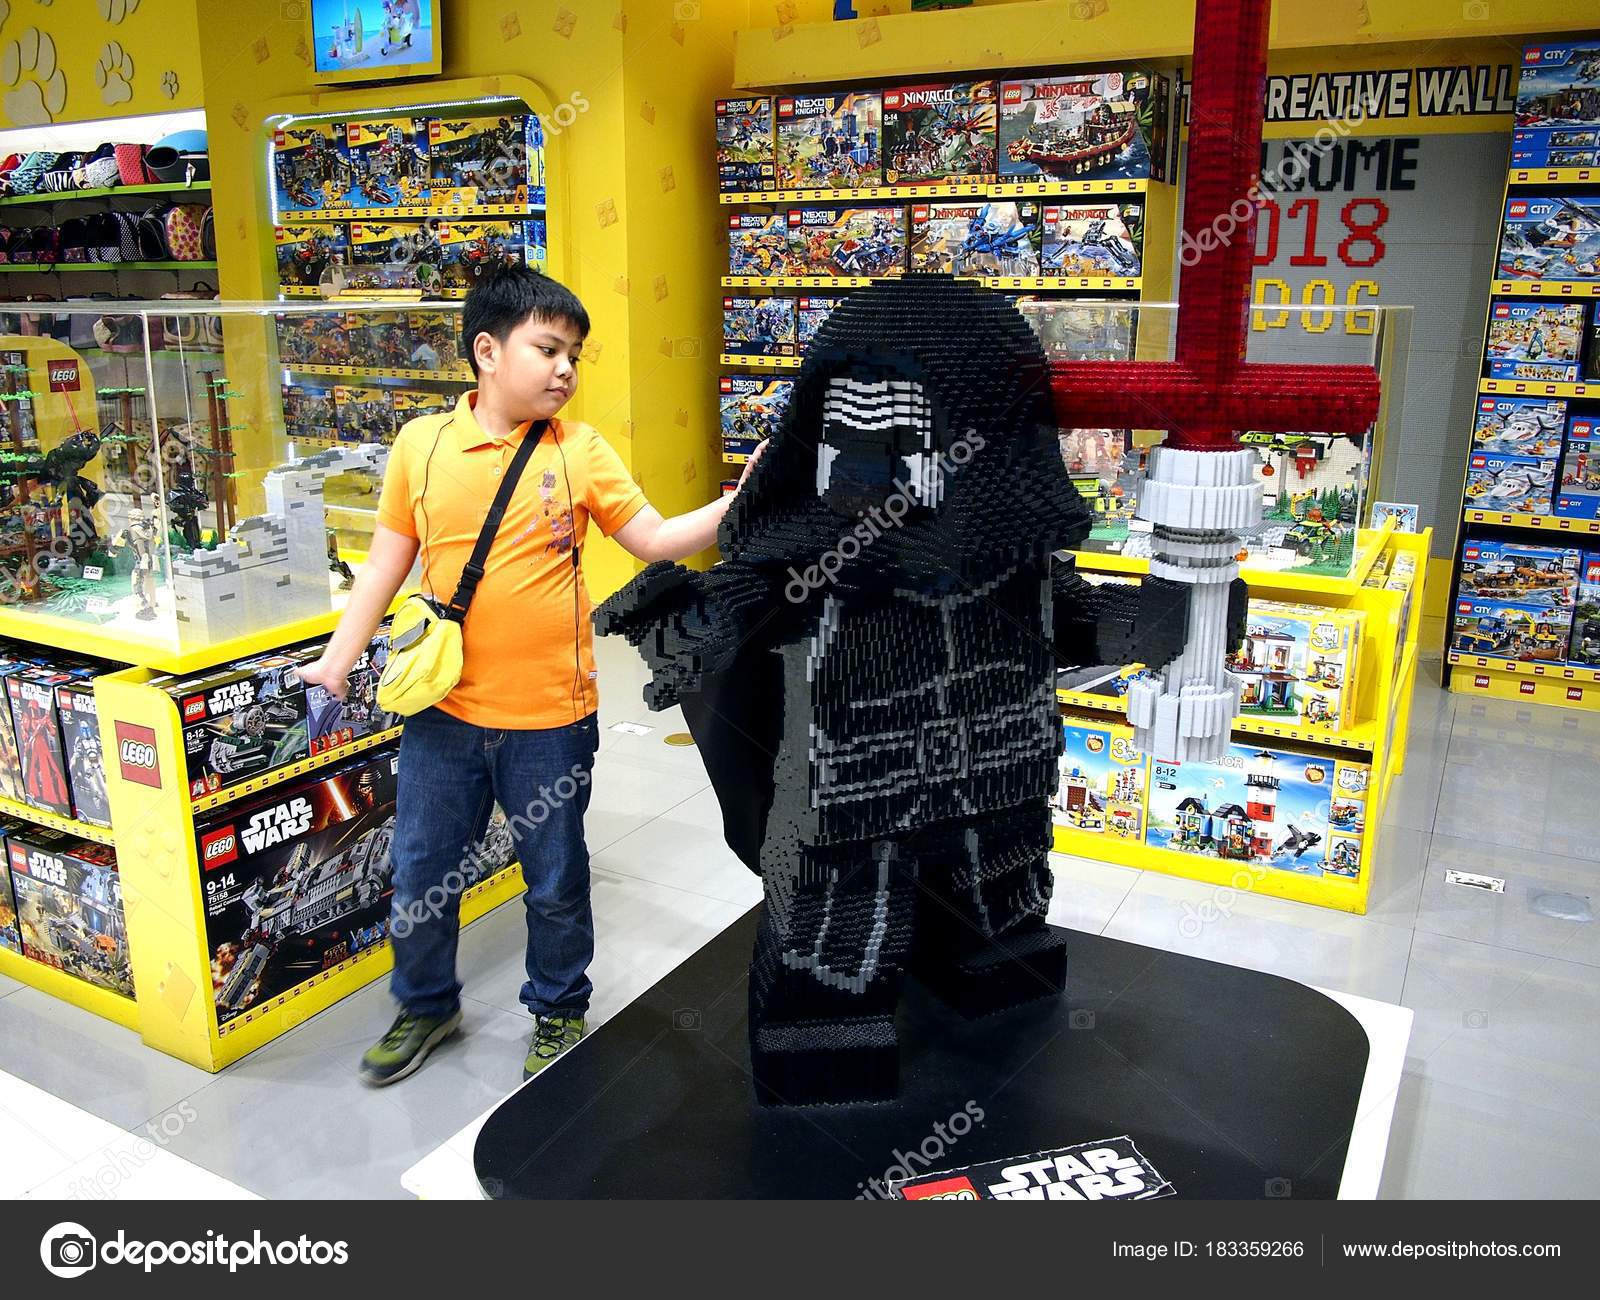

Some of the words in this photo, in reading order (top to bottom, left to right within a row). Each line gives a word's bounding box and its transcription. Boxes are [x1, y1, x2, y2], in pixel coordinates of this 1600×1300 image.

[1544, 50, 1566, 60] CITY
[1004, 89, 1021, 100] LEGO
[1035, 82, 1091, 98] NINJAGO
[1267, 73, 1409, 120] REATIVE
[1420, 68, 1515, 115] WALL
[795, 98, 825, 108] NEXO
[884, 96, 899, 105] LEGO
[902, 89, 955, 106] NINJAGO
[779, 103, 793, 113] LEGO
[795, 106, 825, 115] KNIGHTS
[884, 113, 898, 121] 8-14
[802, 210, 828, 219] NEXO
[936, 207, 977, 219] NINJAGO
[1066, 208, 1108, 220] NINJAGO
[1530, 205, 1554, 214] CITY
[1252, 199, 1390, 267] 018
[1252, 279, 1380, 335] DOG
[1511, 307, 1530, 316] CITY
[51, 368, 77, 383] LEGO
[1497, 402, 1515, 410] CITY
[1573, 425, 1590, 433] LEGO
[1569, 442, 1586, 450] 5-12
[1465, 550, 1479, 558] LEGO
[1481, 551, 1500, 560] CITY
[1587, 566, 1600, 576] LEG
[1458, 604, 1472, 612] LEGO
[1474, 606, 1492, 614] CITY
[213, 680, 256, 703] STAR
[310, 689, 326, 700] 7-12
[208, 690, 256, 716] WARS
[184, 702, 206, 717] LEGO
[186, 728, 205, 741] 8-12
[120, 738, 157, 770] LEGO
[1155, 766, 1177, 777] 8-12
[241, 797, 313, 838] STAR
[241, 816, 314, 855] WARS
[205, 836, 236, 861] LEGO
[29, 851, 64, 872] STAR
[30, 862, 68, 887] WARS
[206, 872, 236, 895] 9-14
[208, 891, 229, 904] 75158
[220, 1011, 238, 1022] Disney
[988, 1147, 1143, 1189] STAR
